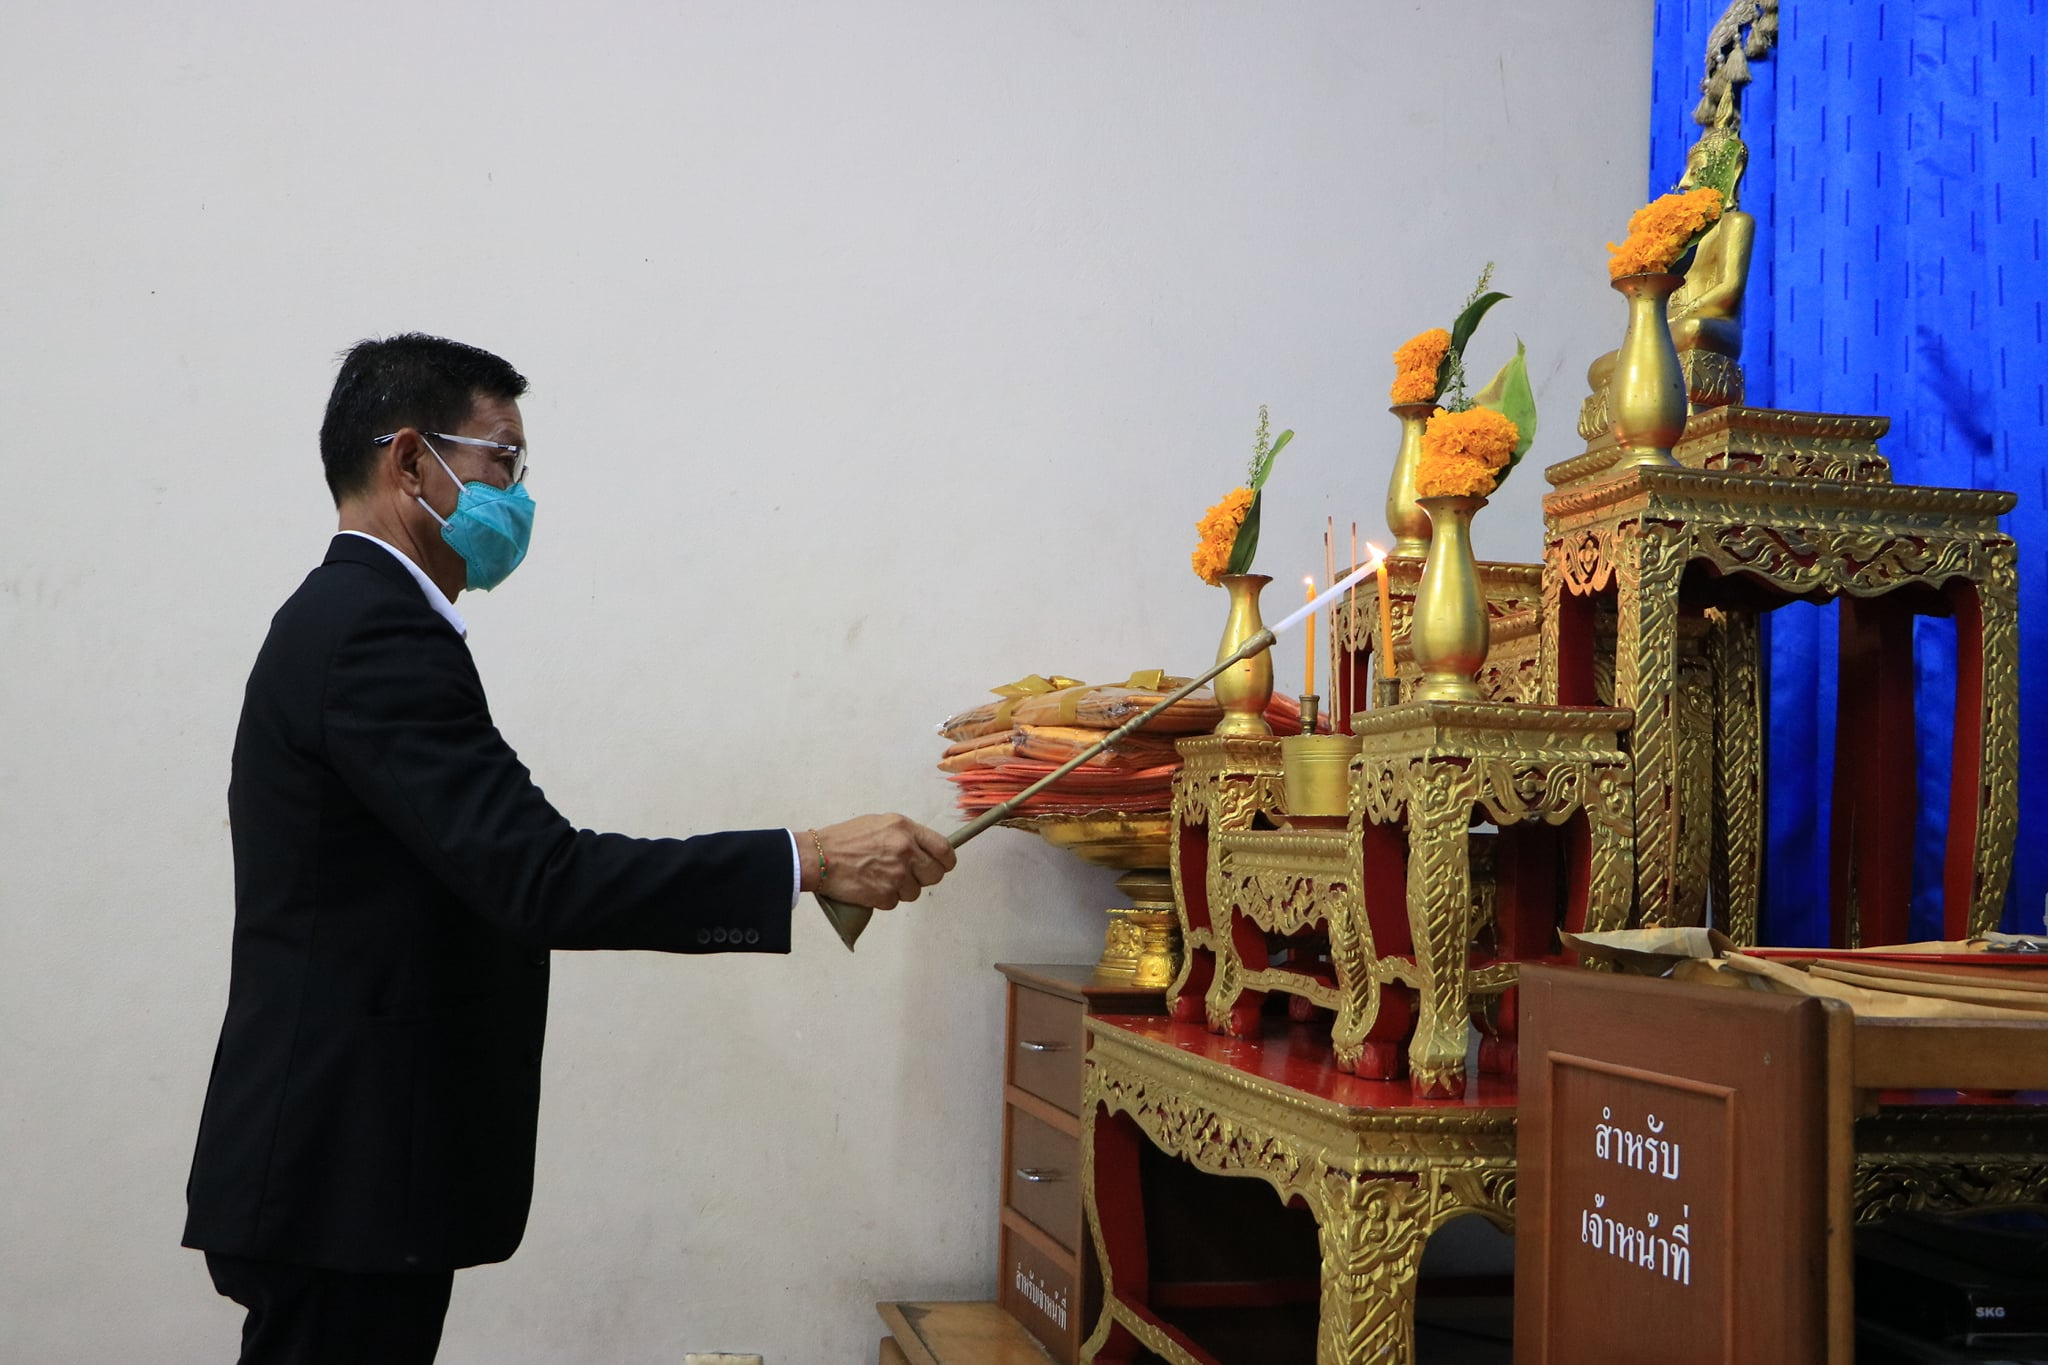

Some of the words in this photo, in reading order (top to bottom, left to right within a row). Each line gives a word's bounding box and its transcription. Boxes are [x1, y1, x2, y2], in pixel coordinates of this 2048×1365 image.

[1595, 1106, 1680, 1180] สำหรับ
[1581, 1193, 1690, 1286] เจ้าหน้าที่
[1975, 1306, 2006, 1318] SKG
